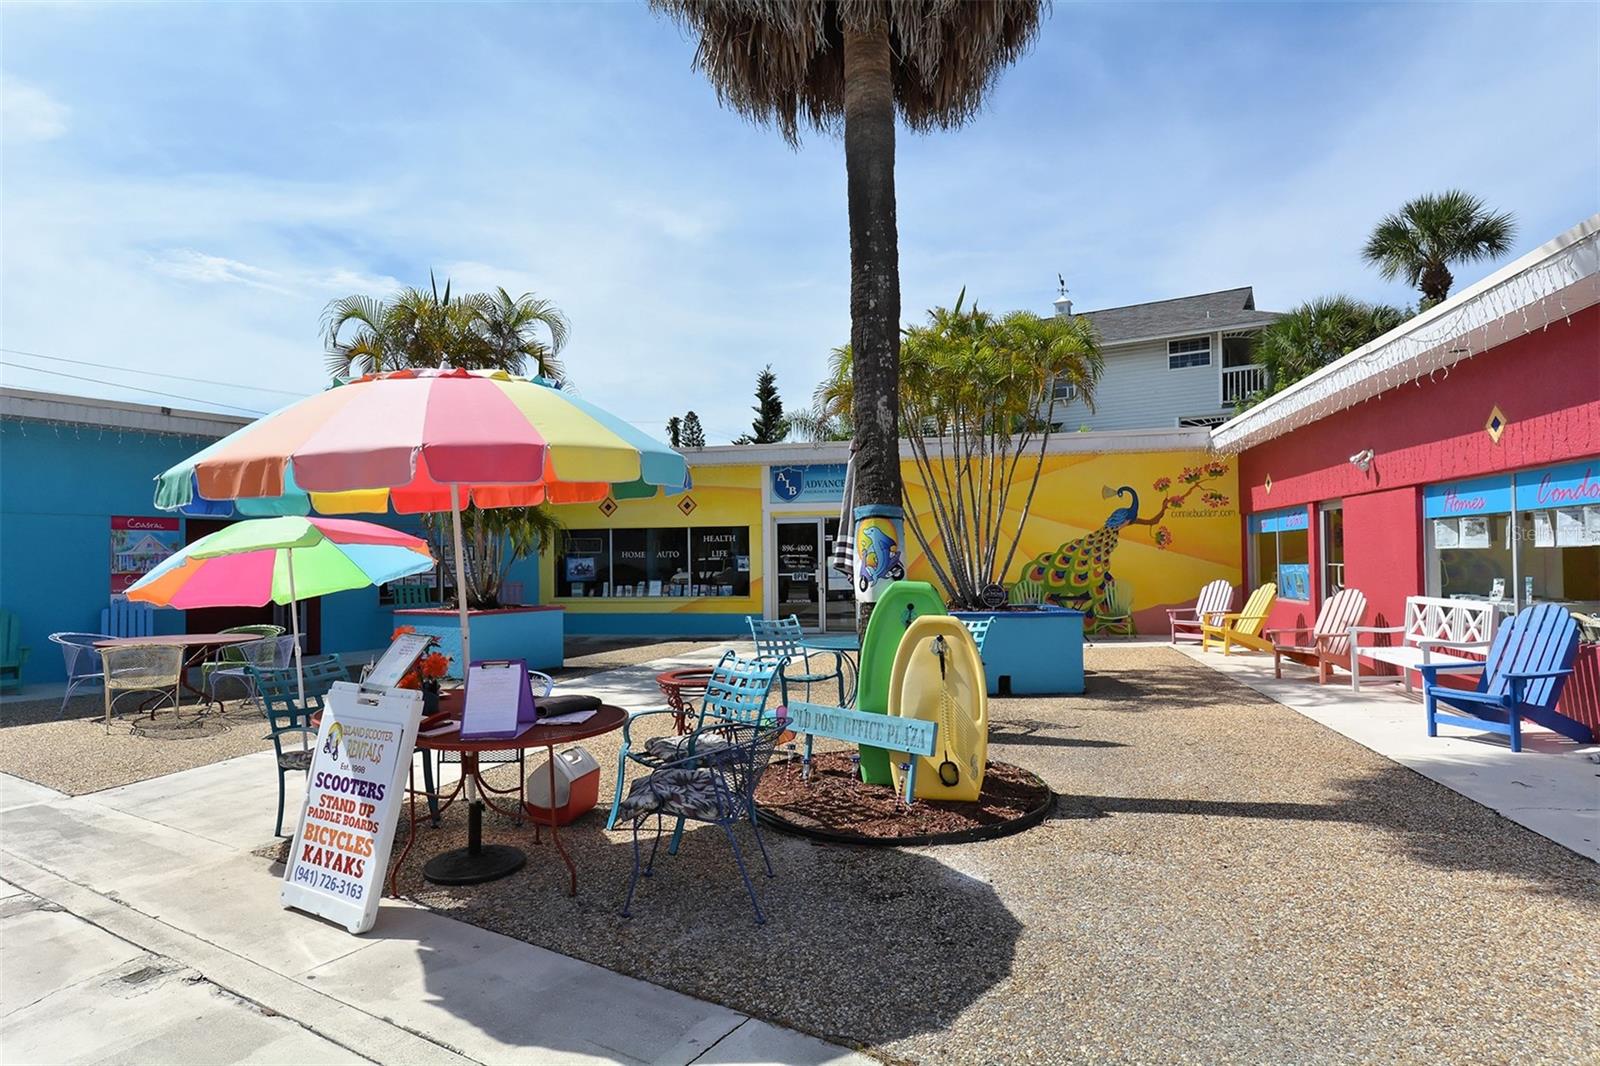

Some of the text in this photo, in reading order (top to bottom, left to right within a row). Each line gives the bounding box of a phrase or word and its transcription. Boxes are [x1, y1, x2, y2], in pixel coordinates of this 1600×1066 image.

[1443, 487, 1487, 513] Homes
[703, 534, 736, 543] HEALTH
[621, 550, 680, 559] HOME AUTO
[711, 550, 728, 558] LIFE
[364, 728, 394, 742] SCOOTER
[814, 713, 839, 734] POST
[843, 717, 884, 742] OFFICE
[887, 724, 926, 749] PLAZA
[346, 738, 385, 764] RENTALS
[315, 771, 386, 801] SCOOTERS
[319, 793, 376, 818] STAND UP
[307, 806, 380, 834] PADDLE BOARDS
[303, 822, 374, 857] BICYCLES
[301, 843, 366, 879] KAYAKS
[294, 865, 364, 900] (941) 726-3163
